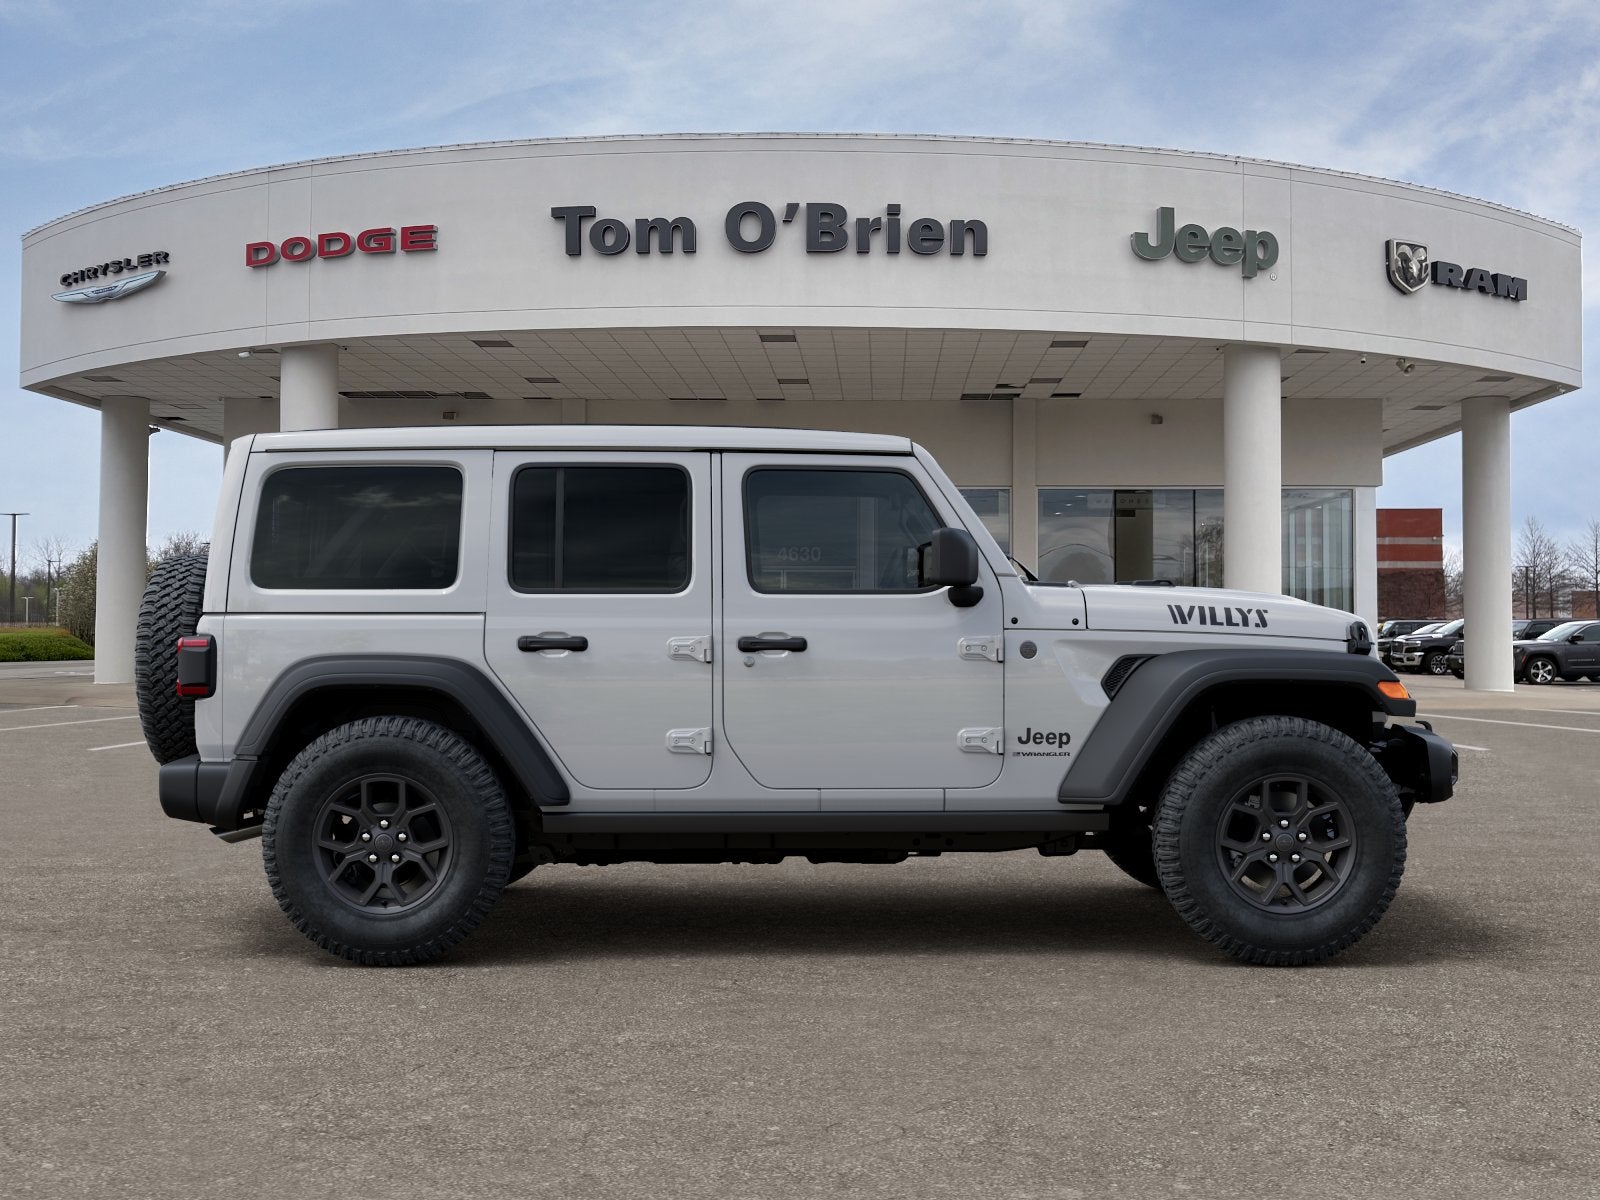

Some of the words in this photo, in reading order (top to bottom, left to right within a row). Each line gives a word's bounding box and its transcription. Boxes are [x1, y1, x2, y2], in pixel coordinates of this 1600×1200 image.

[246, 224, 438, 268] DODGE
[551, 205, 697, 256] Tom
[725, 201, 988, 256] O'Brien
[1131, 206, 1279, 279] Jeep
[60, 251, 170, 287] CHRYSLER
[1431, 260, 1528, 301] RAM
[777, 546, 822, 562] 4630
[1167, 604, 1268, 628] WILLYS
[1017, 727, 1071, 748] Jeep
